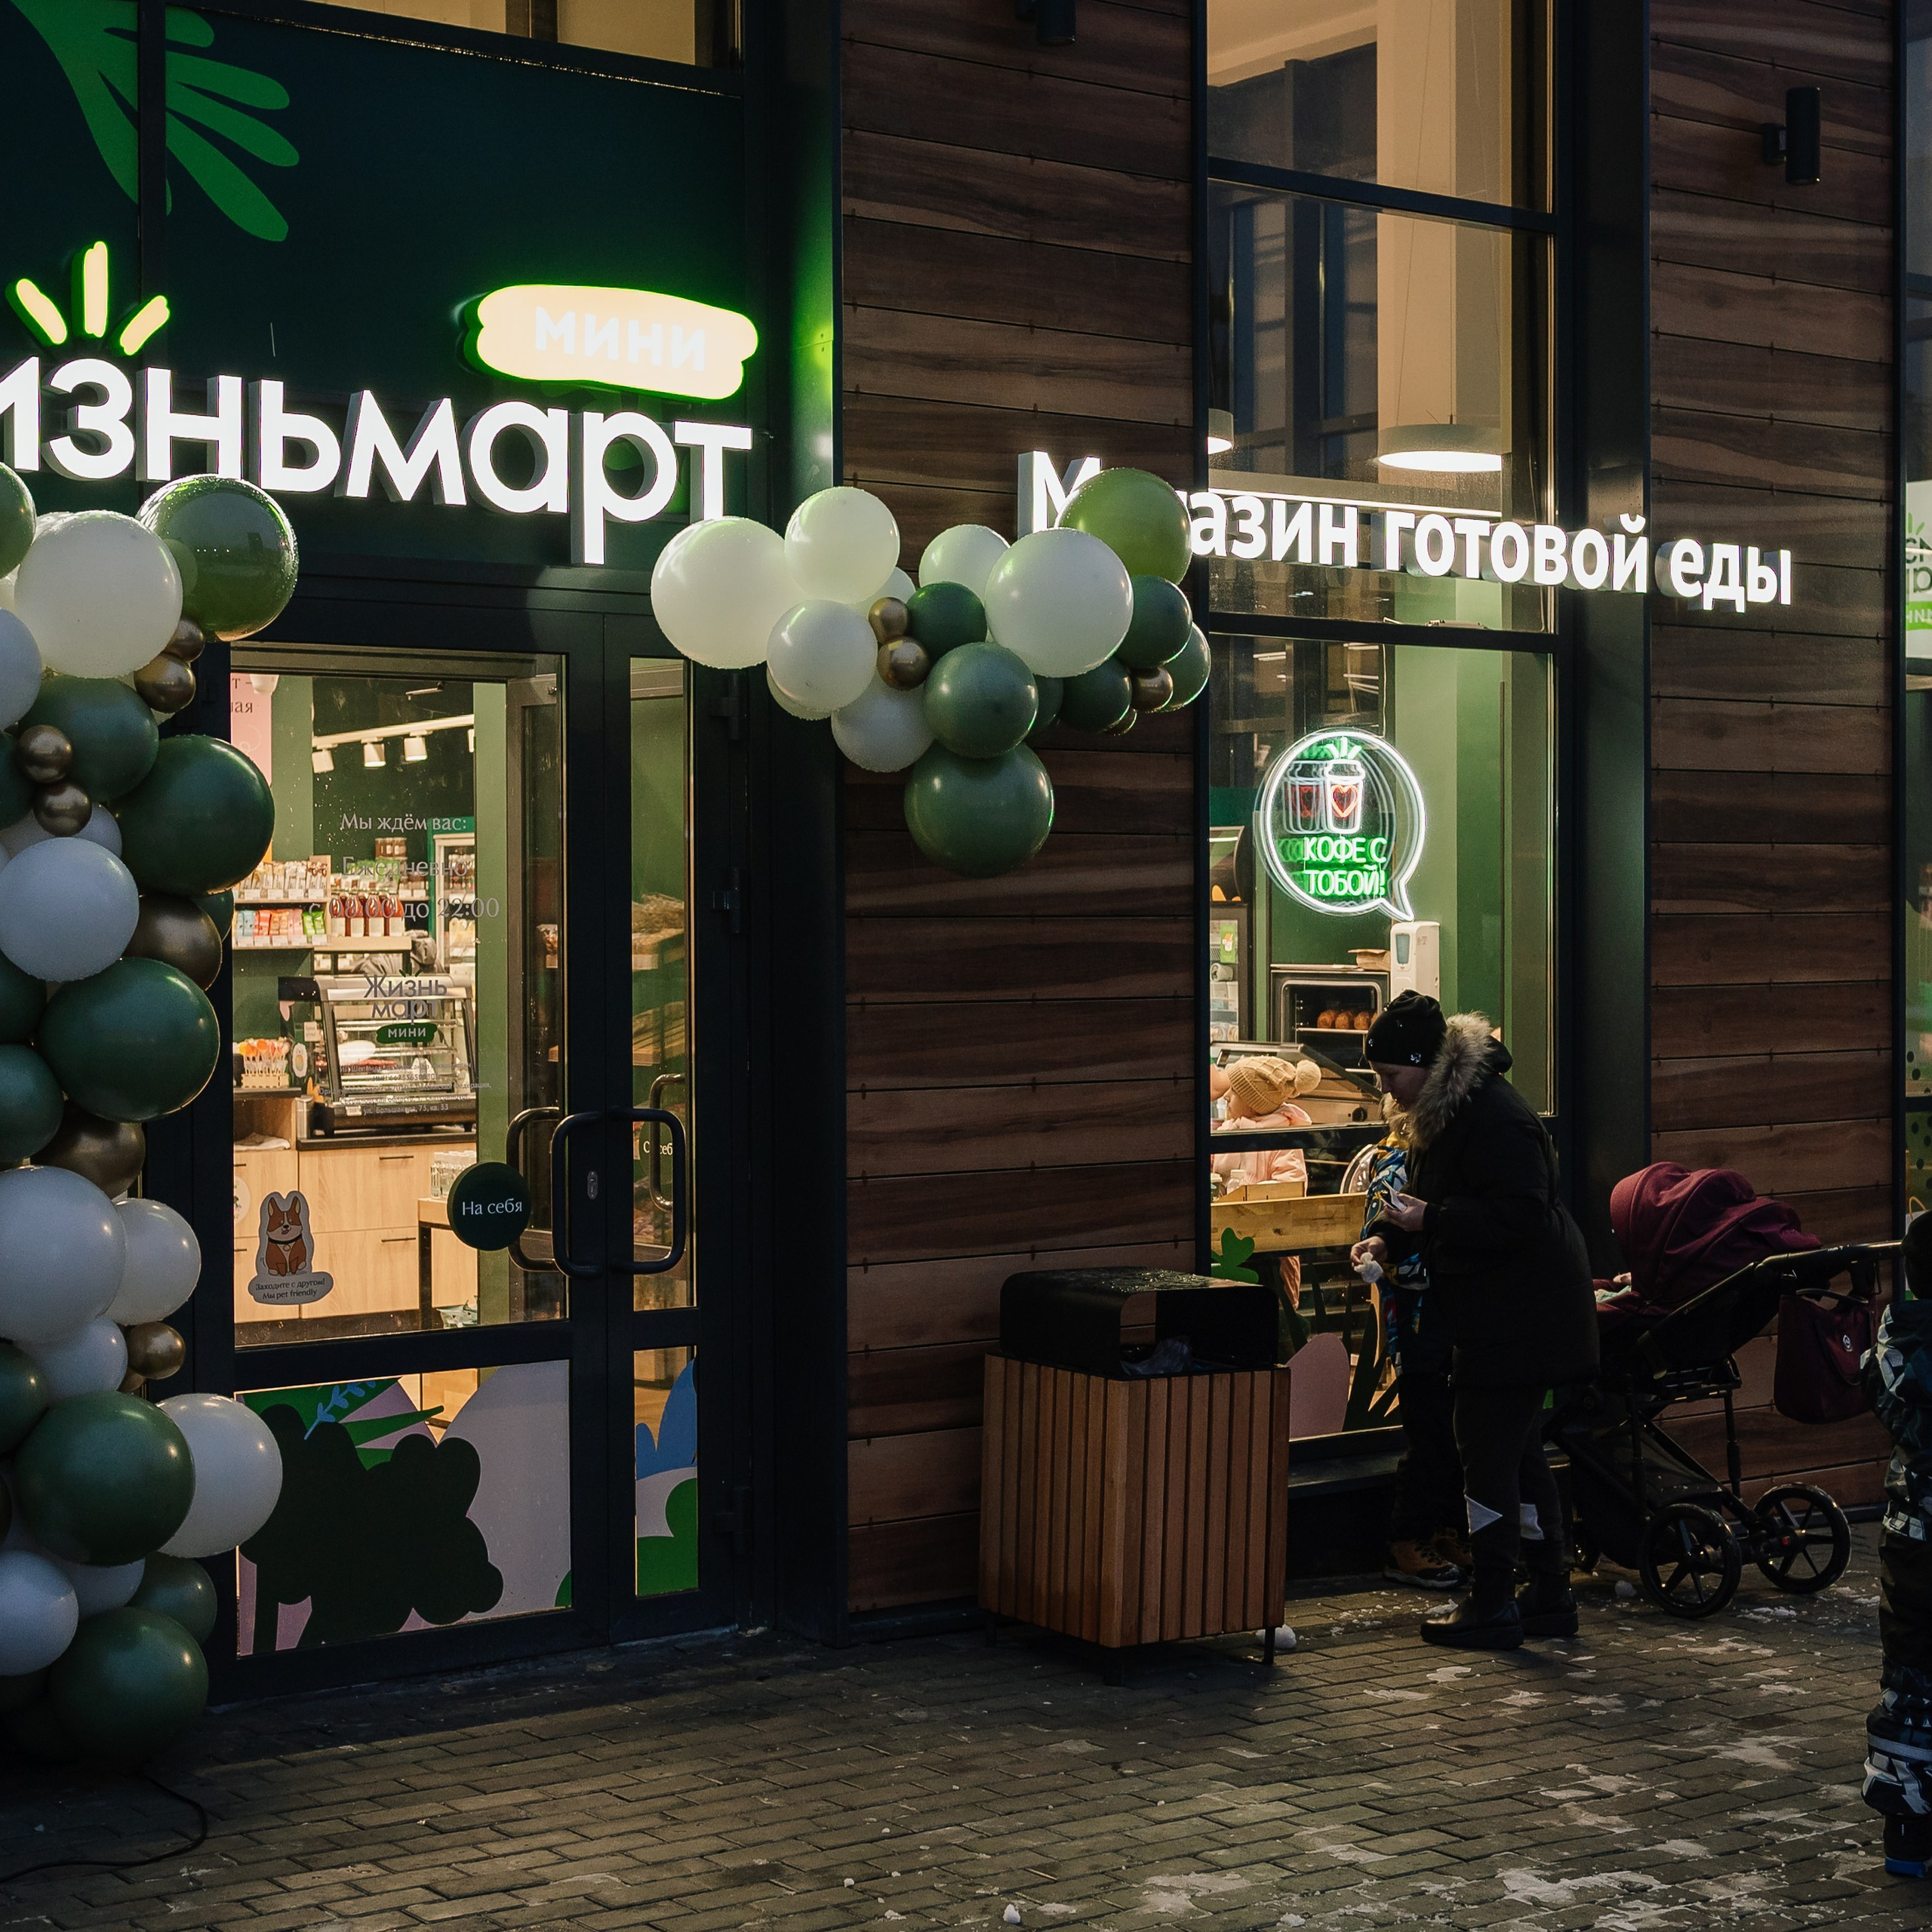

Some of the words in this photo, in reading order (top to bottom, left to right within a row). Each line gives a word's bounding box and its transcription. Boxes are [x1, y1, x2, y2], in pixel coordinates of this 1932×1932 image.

[1386, 510, 1650, 594] готовой
[1669, 538, 1792, 614] еды
[341, 813, 372, 830] Мы
[377, 813, 427, 832] ждём
[432, 816, 467, 830] вас:
[1303, 835, 1366, 863] КОФЕ
[342, 856, 468, 881] Ежедневно
[1303, 865, 1386, 897] ТОБОЙ!
[401, 902, 429, 921] до
[437, 897, 500, 918] 22:00
[363, 973, 448, 998] Жизнь
[371, 999, 441, 1025] март
[462, 1201, 483, 1216] На
[487, 1198, 523, 1214] себя
[255, 1282, 290, 1291] Заходите
[297, 1278, 325, 1288] другом!
[276, 1291, 288, 1300] pet
[290, 1288, 317, 1298] friendly
